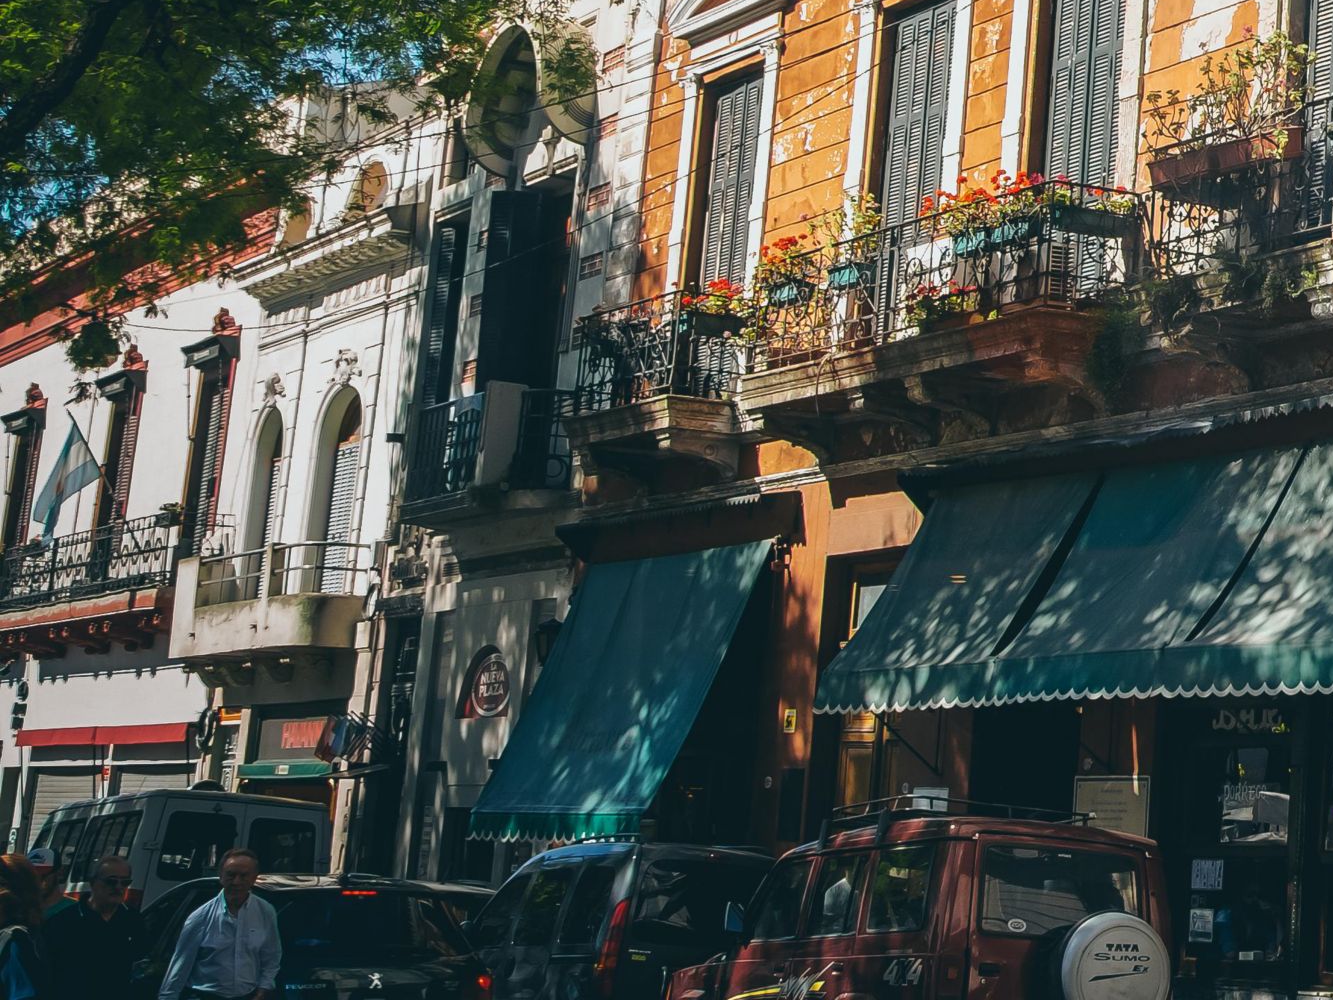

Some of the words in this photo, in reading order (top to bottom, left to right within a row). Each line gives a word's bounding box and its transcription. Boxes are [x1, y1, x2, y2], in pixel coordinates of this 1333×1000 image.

[480, 671, 505, 684] NUEVA
[478, 684, 504, 697] PLAZA
[1106, 943, 1140, 953] TATA
[1094, 952, 1151, 962] SUMO
